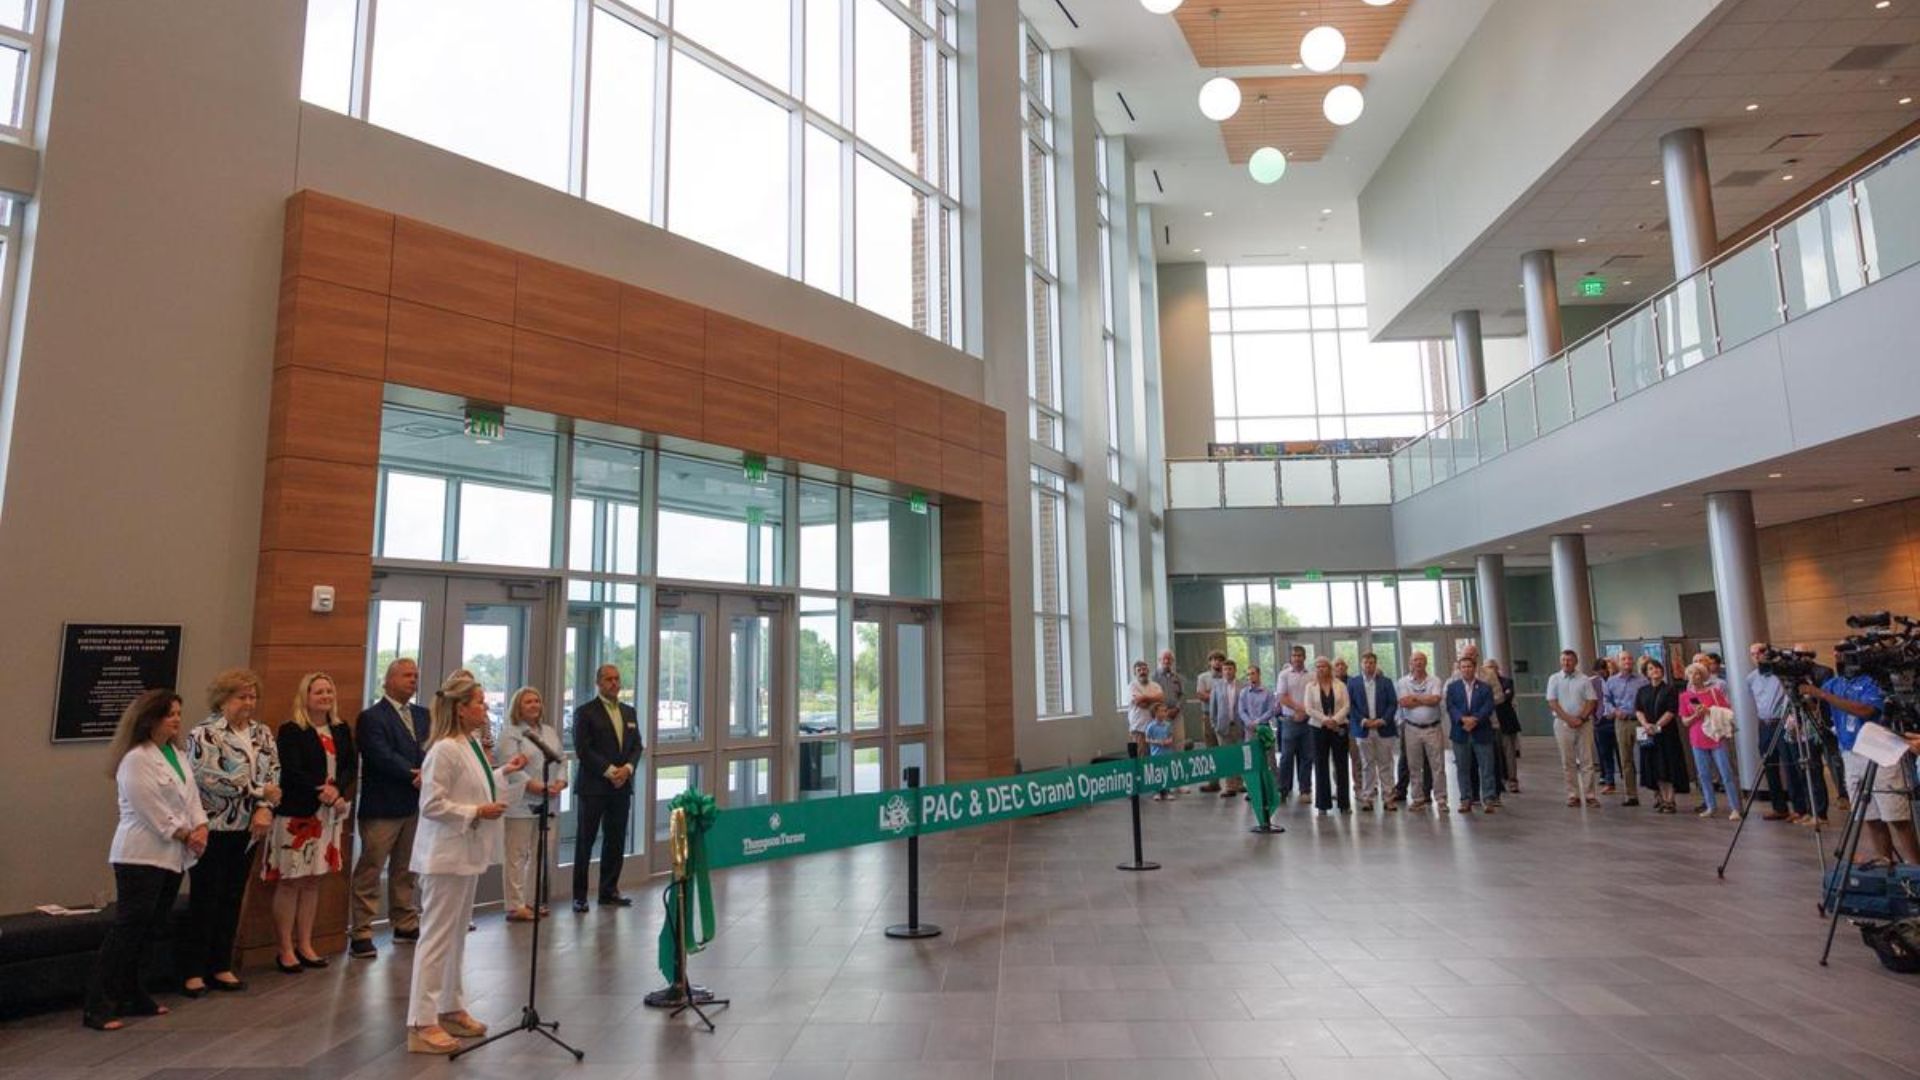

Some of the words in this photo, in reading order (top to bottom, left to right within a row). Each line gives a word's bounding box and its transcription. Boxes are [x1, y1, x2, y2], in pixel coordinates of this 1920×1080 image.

[470, 412, 500, 437] EXIT
[921, 791, 964, 824] PAC
[969, 791, 983, 817] &
[988, 785, 1026, 812] DEC
[1028, 775, 1074, 807] Grand
[1078, 768, 1134, 803] Opening
[1143, 763, 1168, 788] May
[1171, 761, 1189, 783] 01,
[1189, 756, 1216, 778] 2024
